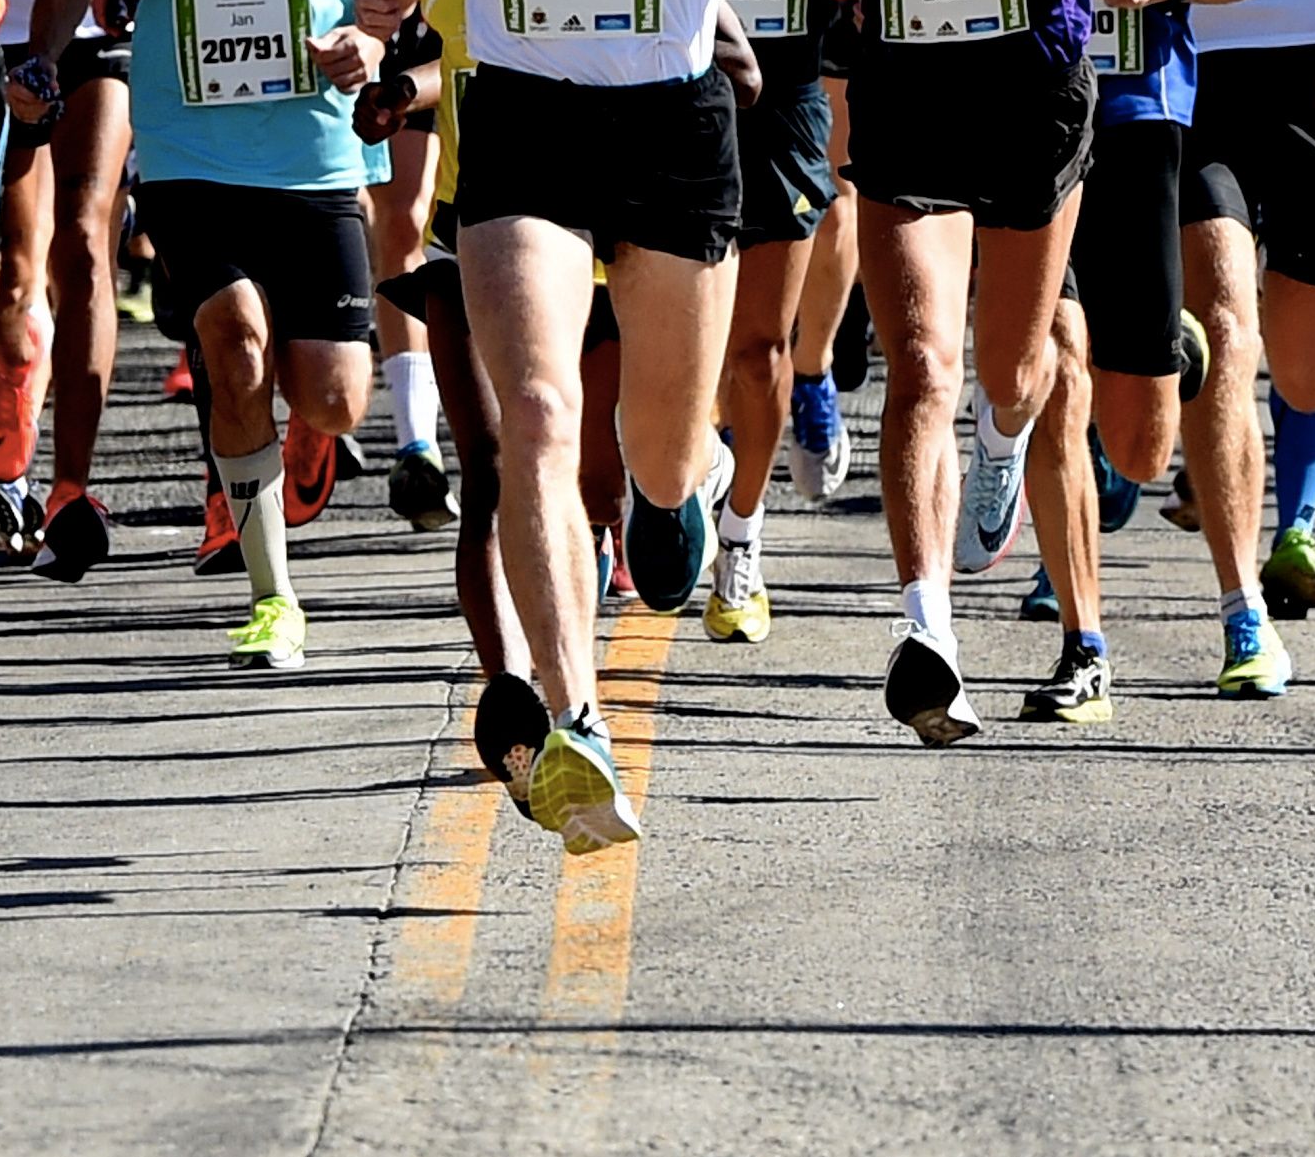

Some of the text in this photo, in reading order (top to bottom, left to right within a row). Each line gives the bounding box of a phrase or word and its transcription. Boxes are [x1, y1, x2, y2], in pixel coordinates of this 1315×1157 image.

[230, 12, 255, 28] Jan
[1090, 9, 1115, 35] 0
[200, 33, 287, 65] 20791
